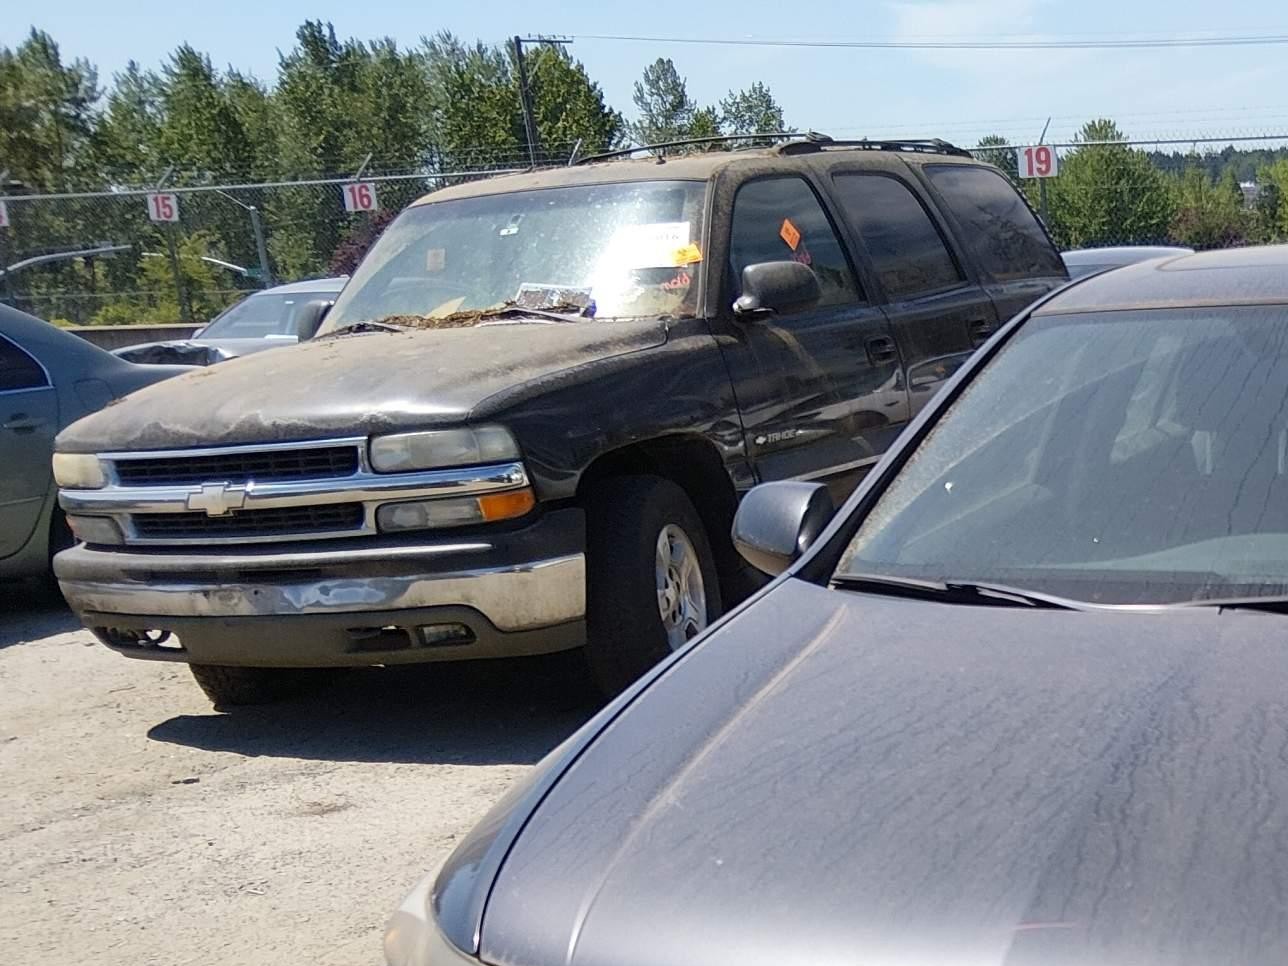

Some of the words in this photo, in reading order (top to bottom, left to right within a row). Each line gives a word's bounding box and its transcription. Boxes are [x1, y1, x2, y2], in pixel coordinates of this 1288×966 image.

[1024, 147, 1051, 176] 19
[152, 195, 174, 220] 15
[348, 184, 373, 210] 16
